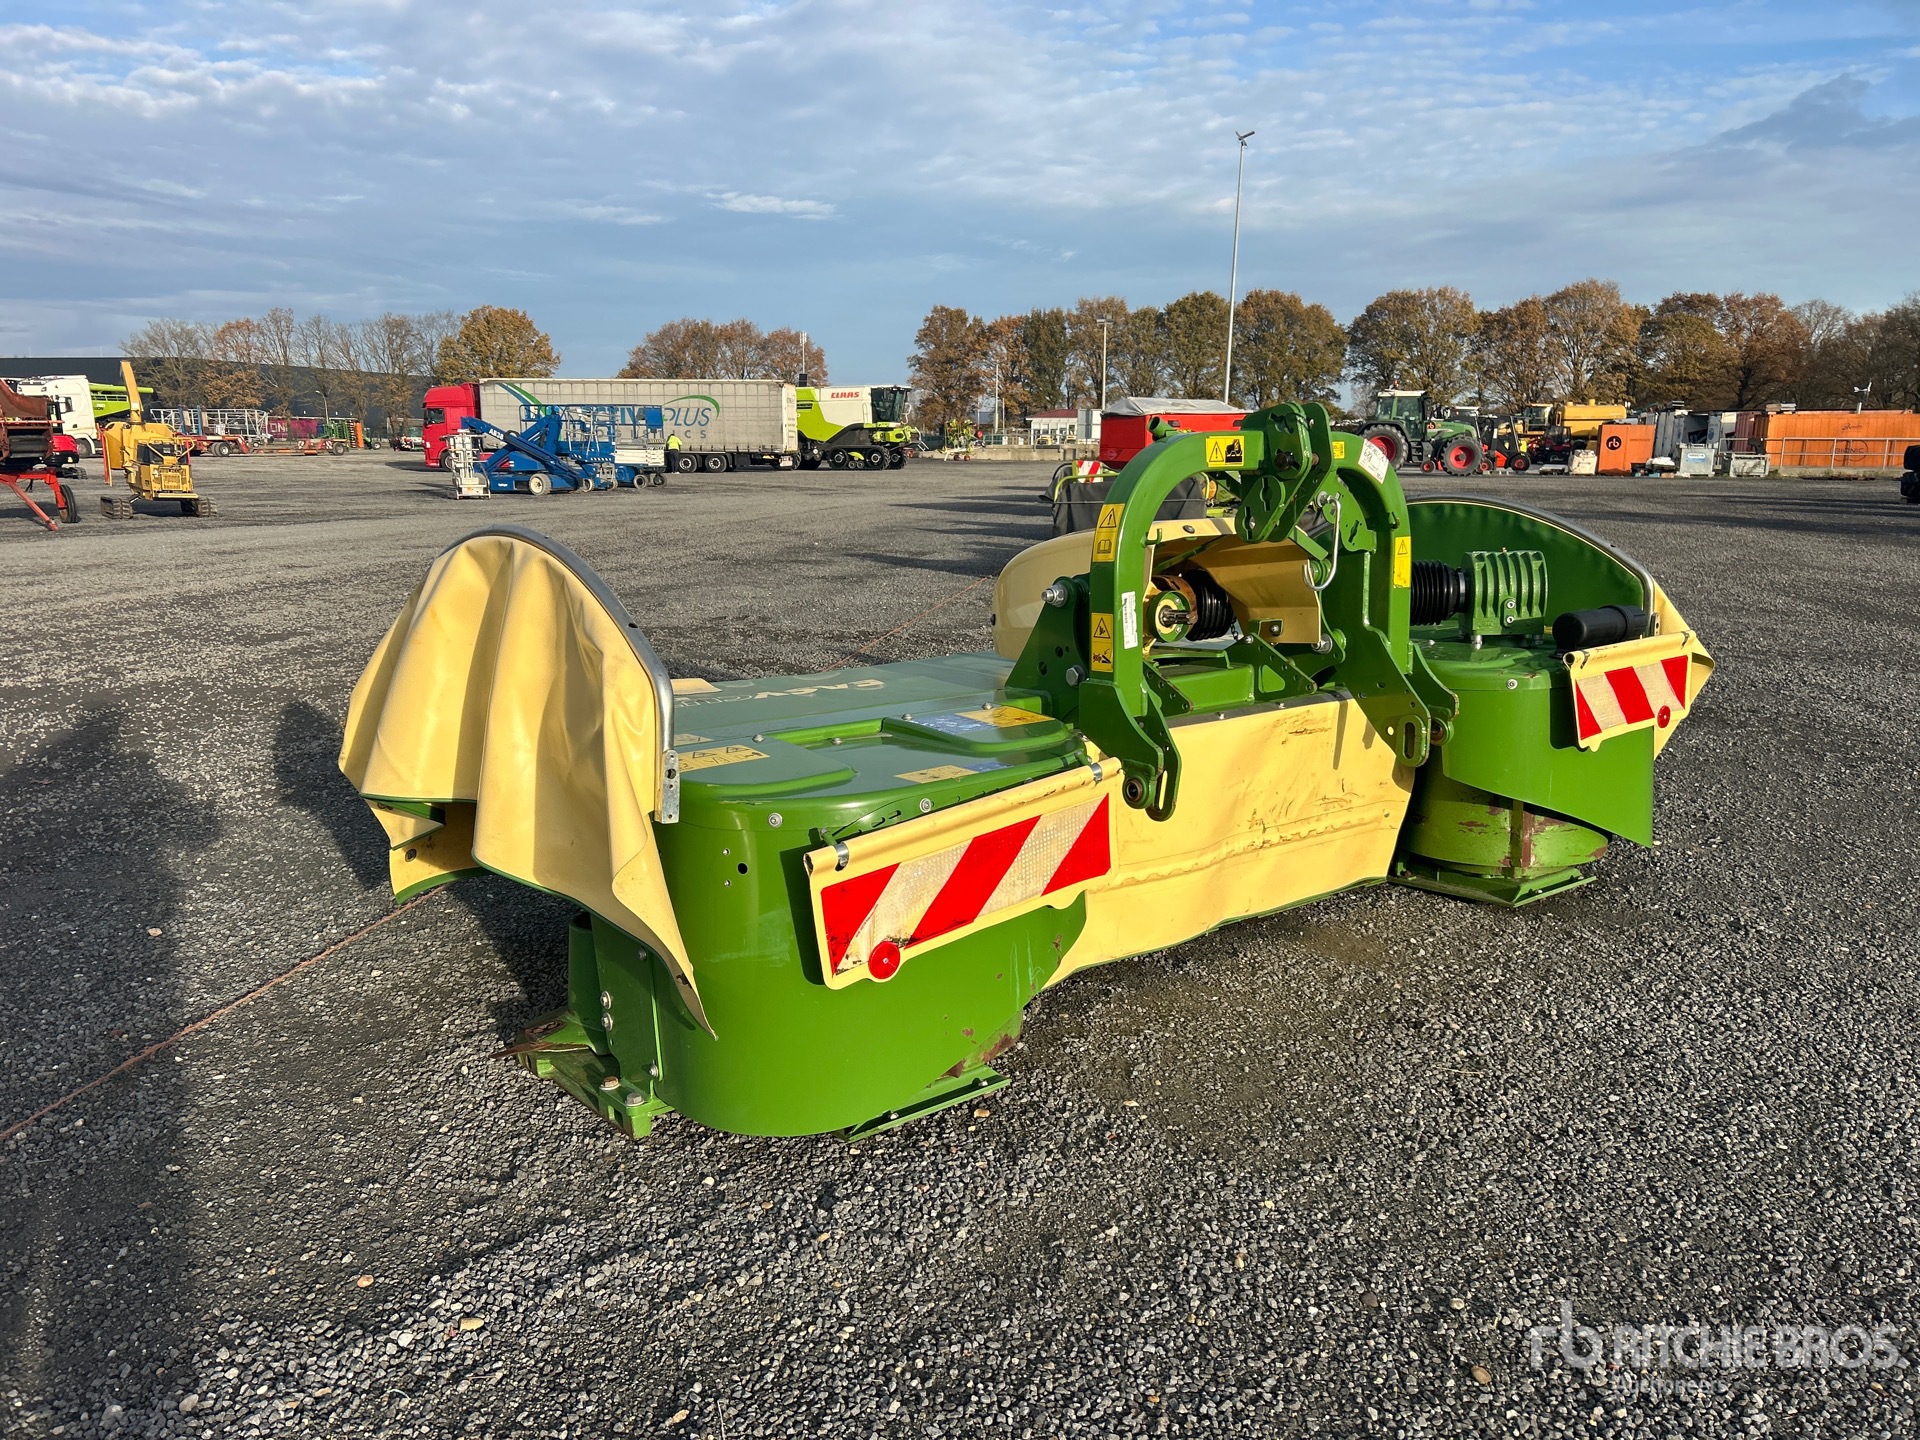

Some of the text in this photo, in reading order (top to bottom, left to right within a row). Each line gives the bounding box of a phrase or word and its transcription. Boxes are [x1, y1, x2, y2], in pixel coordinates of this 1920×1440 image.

[831, 391, 860, 399] CLAAS
[664, 407, 712, 426] PLUS
[1608, 438, 1620, 448] rb
